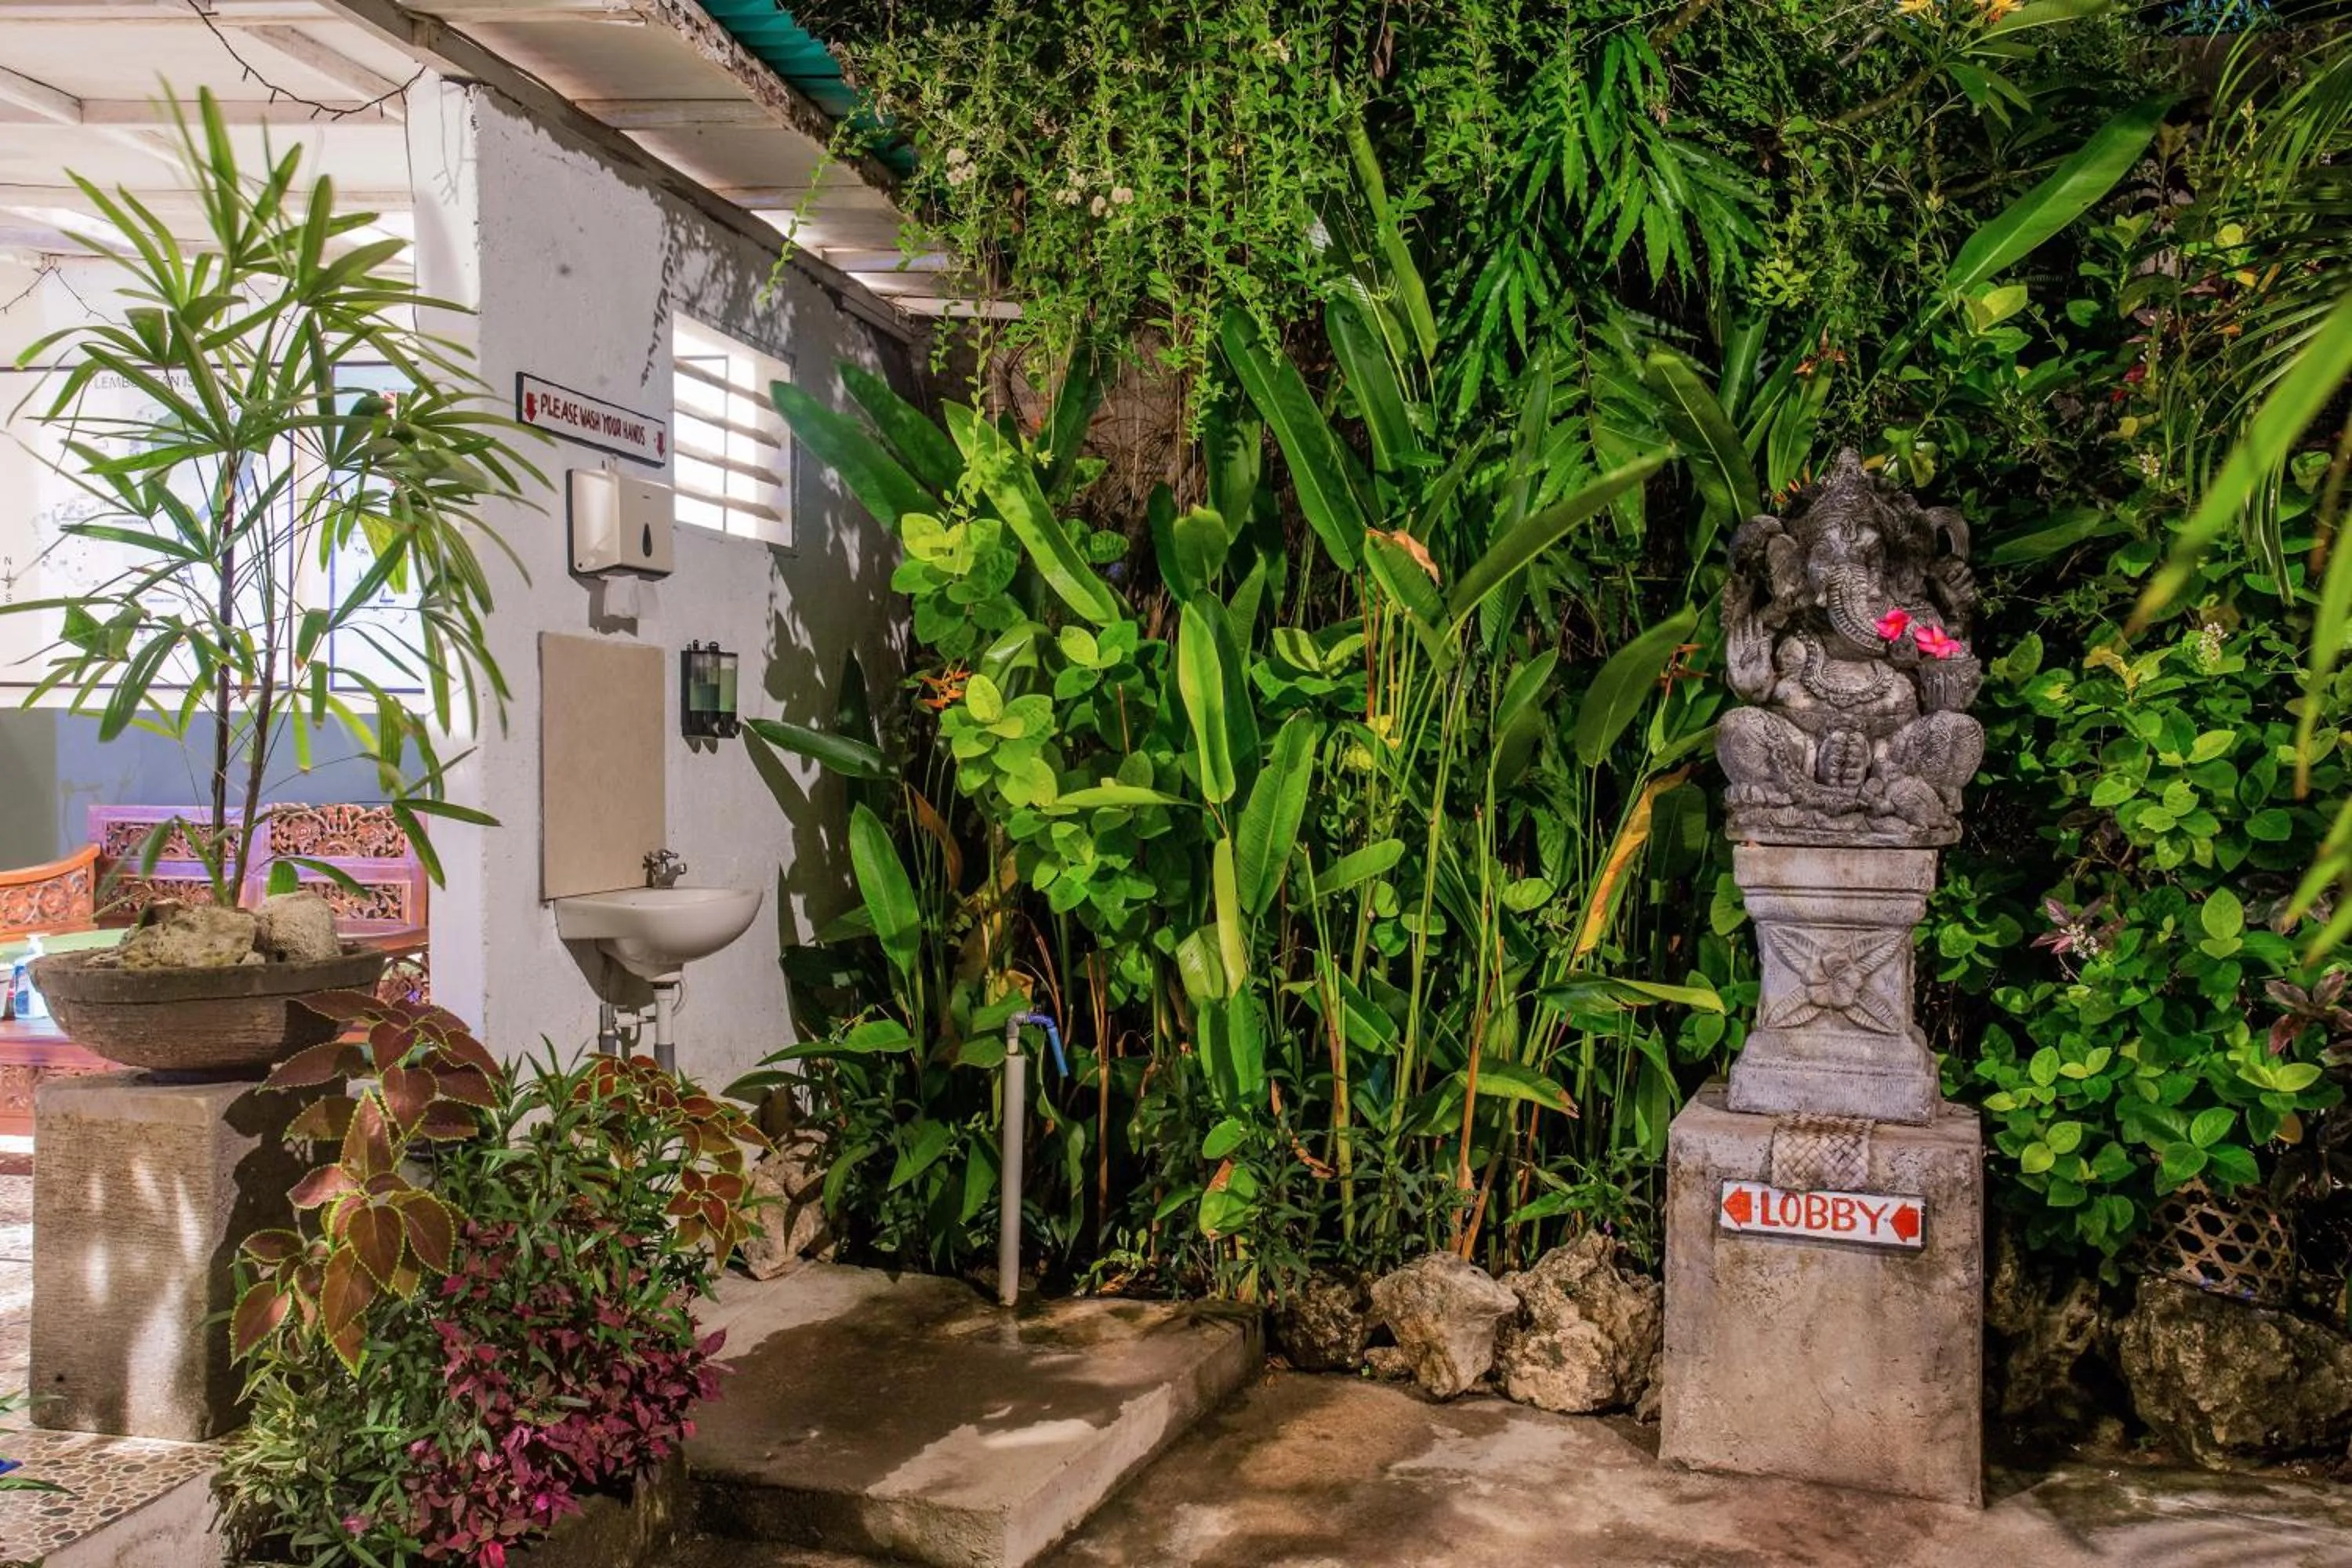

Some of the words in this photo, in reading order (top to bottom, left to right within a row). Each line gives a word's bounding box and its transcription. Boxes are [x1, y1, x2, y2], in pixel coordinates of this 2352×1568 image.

[540, 393, 579, 426] PLEASE
[580, 406, 601, 432] WASH
[601, 413, 622, 437] YOUR
[622, 421, 646, 446] HANDS
[1759, 1189, 1889, 1236] LOBBY
